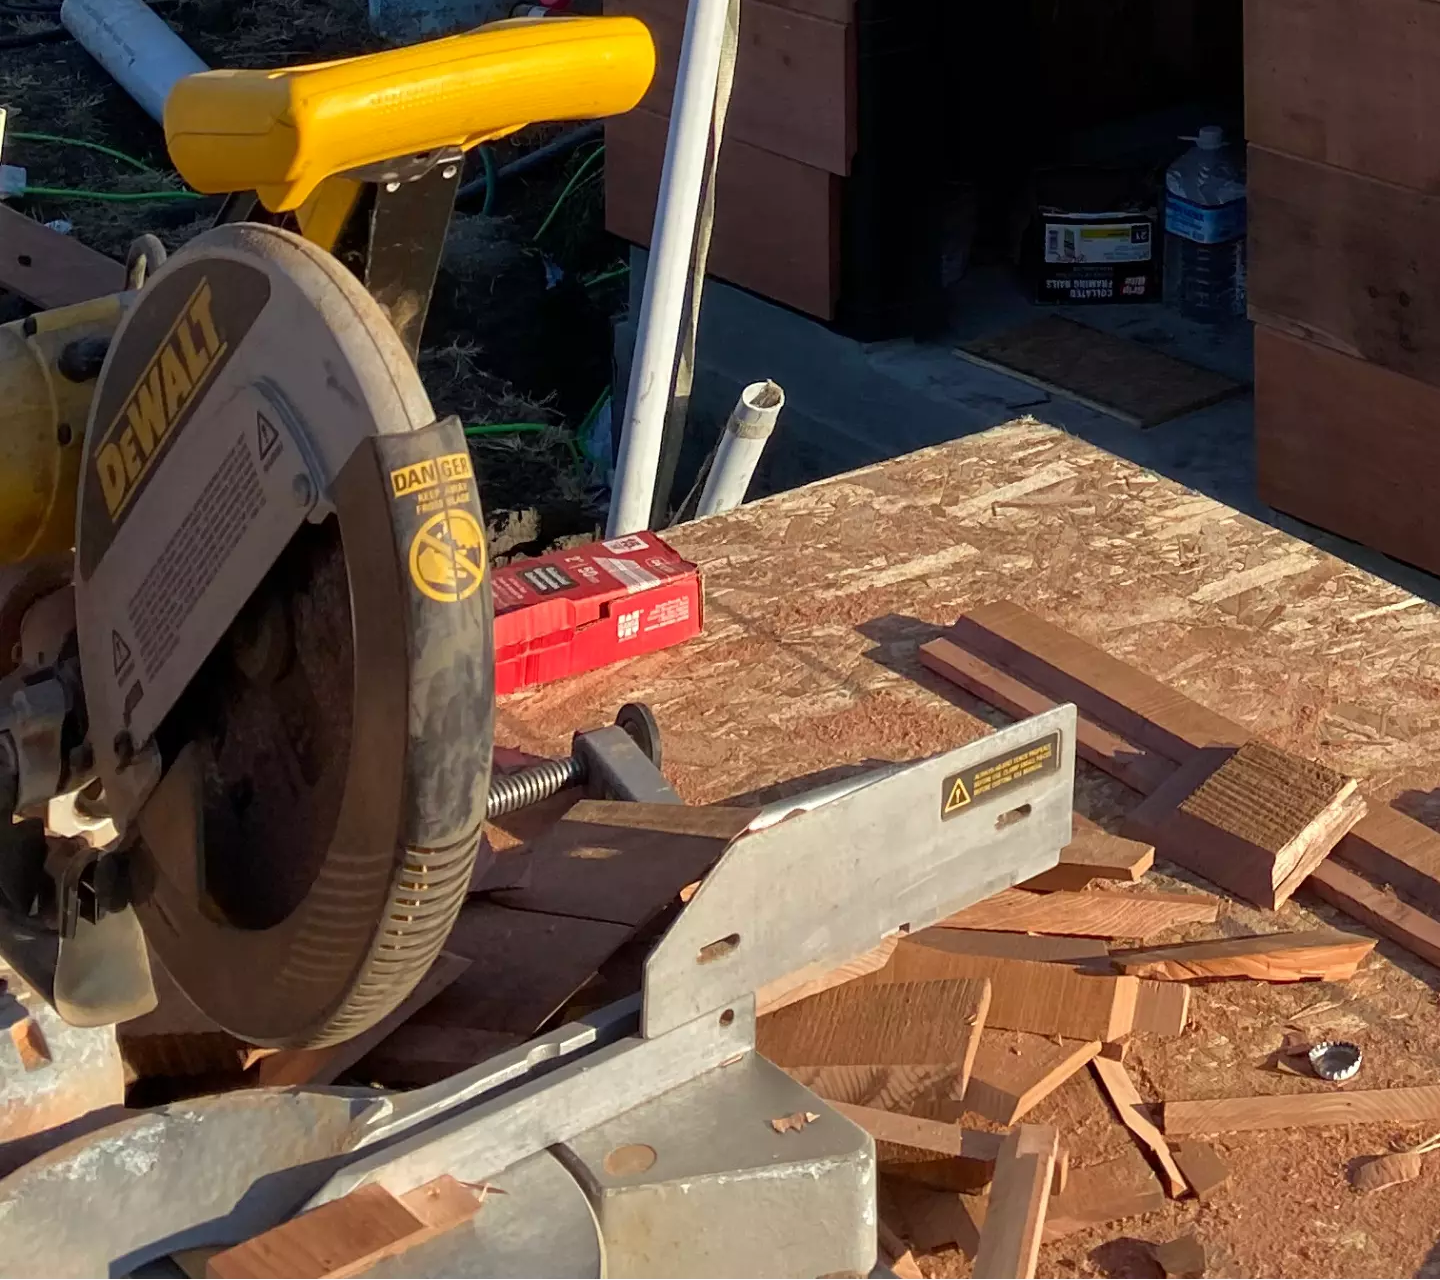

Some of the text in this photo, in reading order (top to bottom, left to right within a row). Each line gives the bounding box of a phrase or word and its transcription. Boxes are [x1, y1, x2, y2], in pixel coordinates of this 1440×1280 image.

[1045, 279, 1113, 289] FRAMING NAILS
[1069, 289, 1113, 299] COLLATED
[393, 457, 468, 492] DANGER
